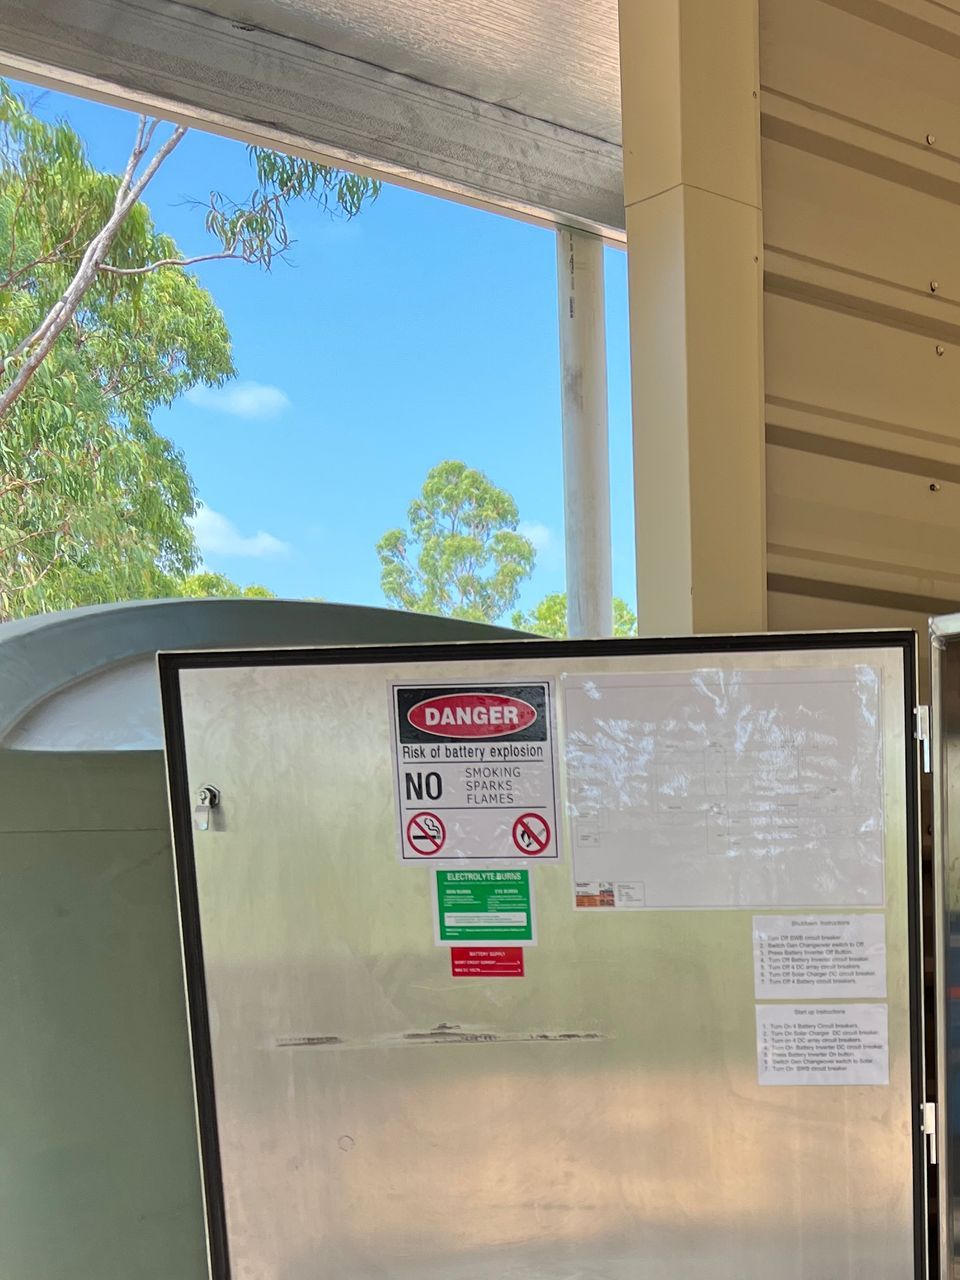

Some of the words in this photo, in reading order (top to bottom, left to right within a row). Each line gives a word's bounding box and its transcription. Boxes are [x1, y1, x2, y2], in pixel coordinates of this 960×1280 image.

[424, 706, 519, 726] DANGER
[402, 746, 426, 760] Risk
[431, 746, 440, 758] of
[446, 745, 484, 762] battery
[490, 744, 544, 760] explosion
[465, 766, 521, 778] SMOKING
[405, 772, 442, 800] NO
[466, 780, 512, 792] SPARKS
[466, 793, 514, 804] FLAMES
[447, 872, 495, 880] ELECTROLYTE
[496, 872, 522, 880] BURNS
